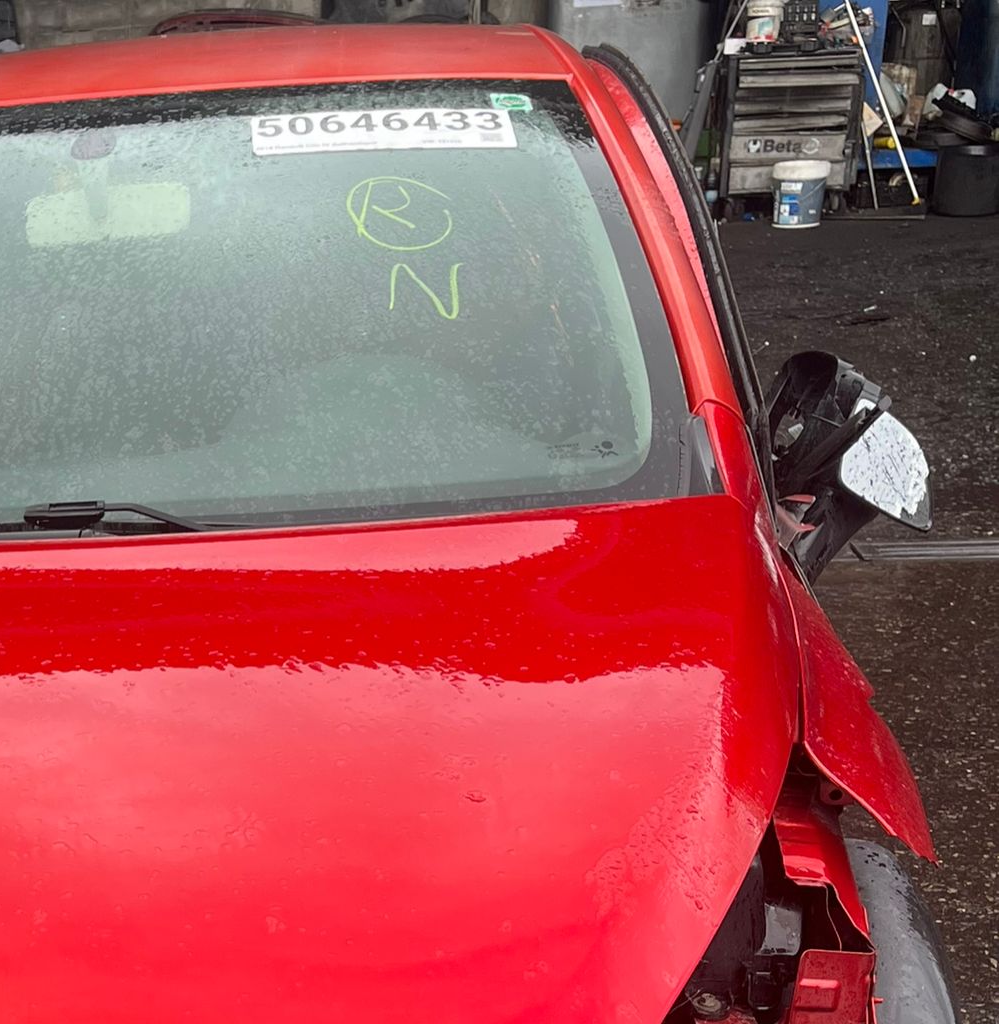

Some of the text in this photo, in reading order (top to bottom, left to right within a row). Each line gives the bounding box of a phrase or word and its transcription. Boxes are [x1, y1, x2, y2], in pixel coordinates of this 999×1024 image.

[257, 111, 503, 137] 50646433
[763, 139, 803, 153] Beta
[389, 262, 464, 320] N
